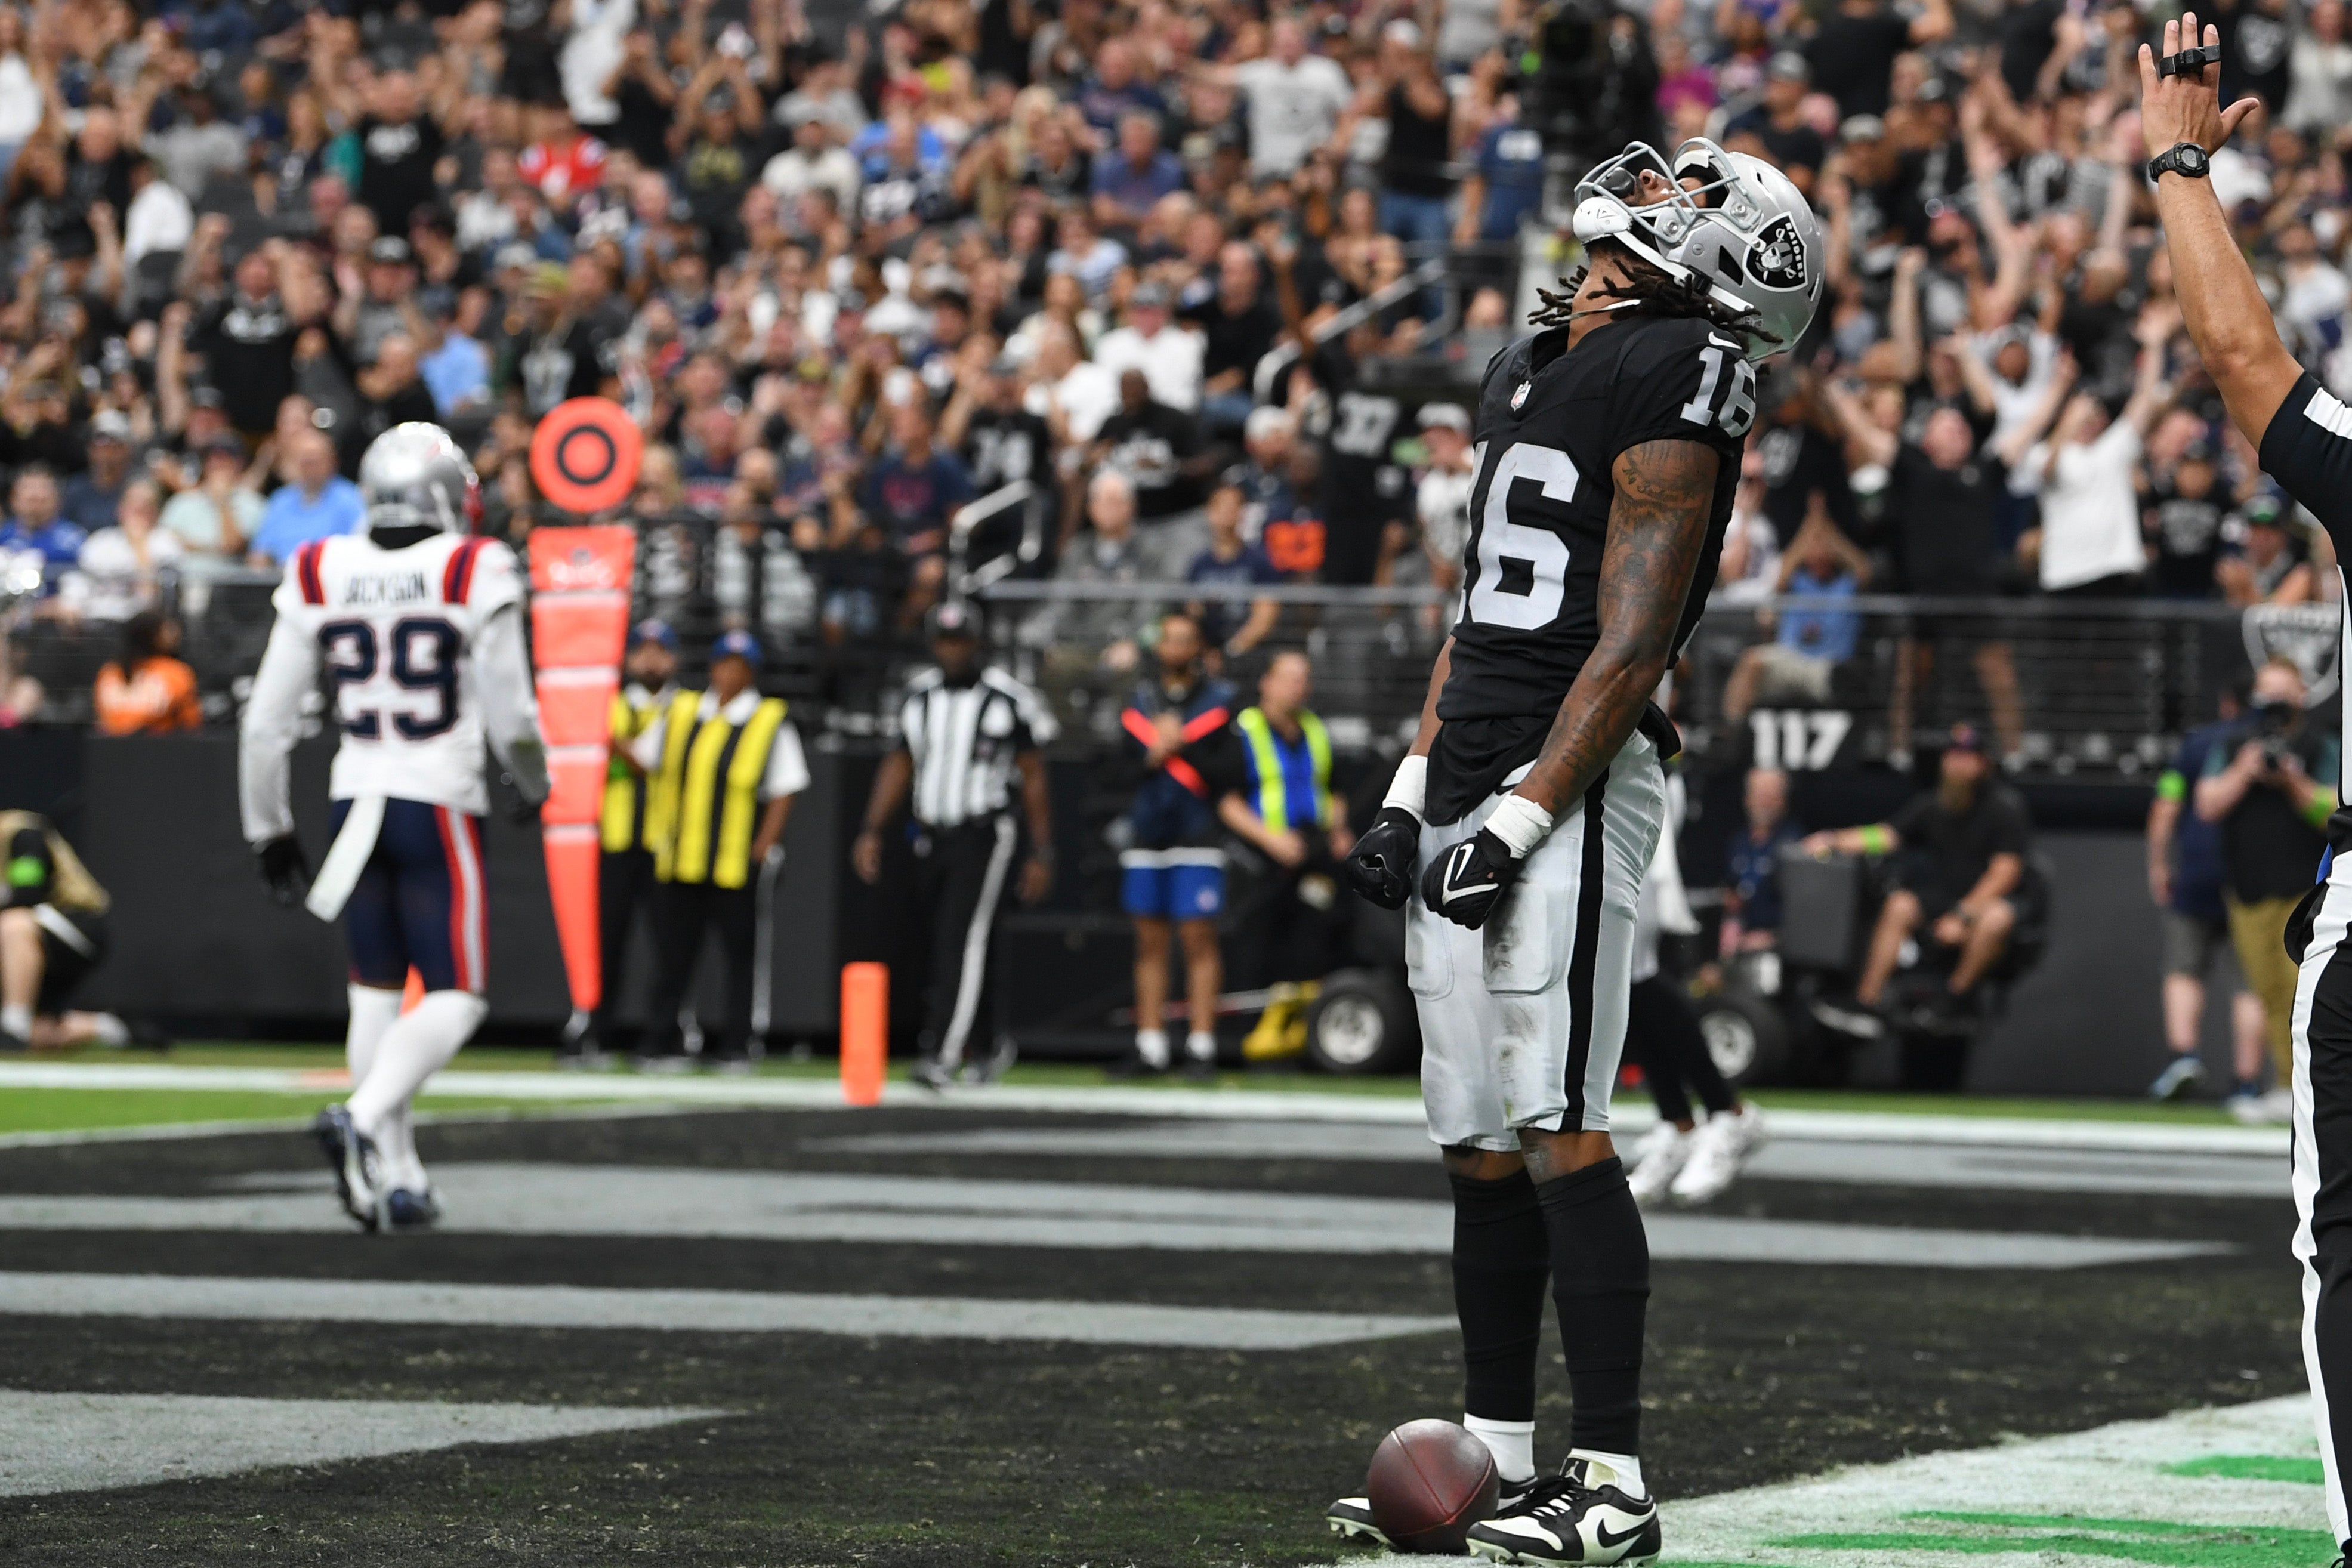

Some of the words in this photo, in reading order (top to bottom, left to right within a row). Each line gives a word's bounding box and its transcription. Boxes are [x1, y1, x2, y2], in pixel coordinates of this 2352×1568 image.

[1785, 222, 1804, 279] RAIDERS
[1680, 346, 1757, 439] 16
[317, 616, 462, 742] 29
[1749, 708, 1854, 771] 117
